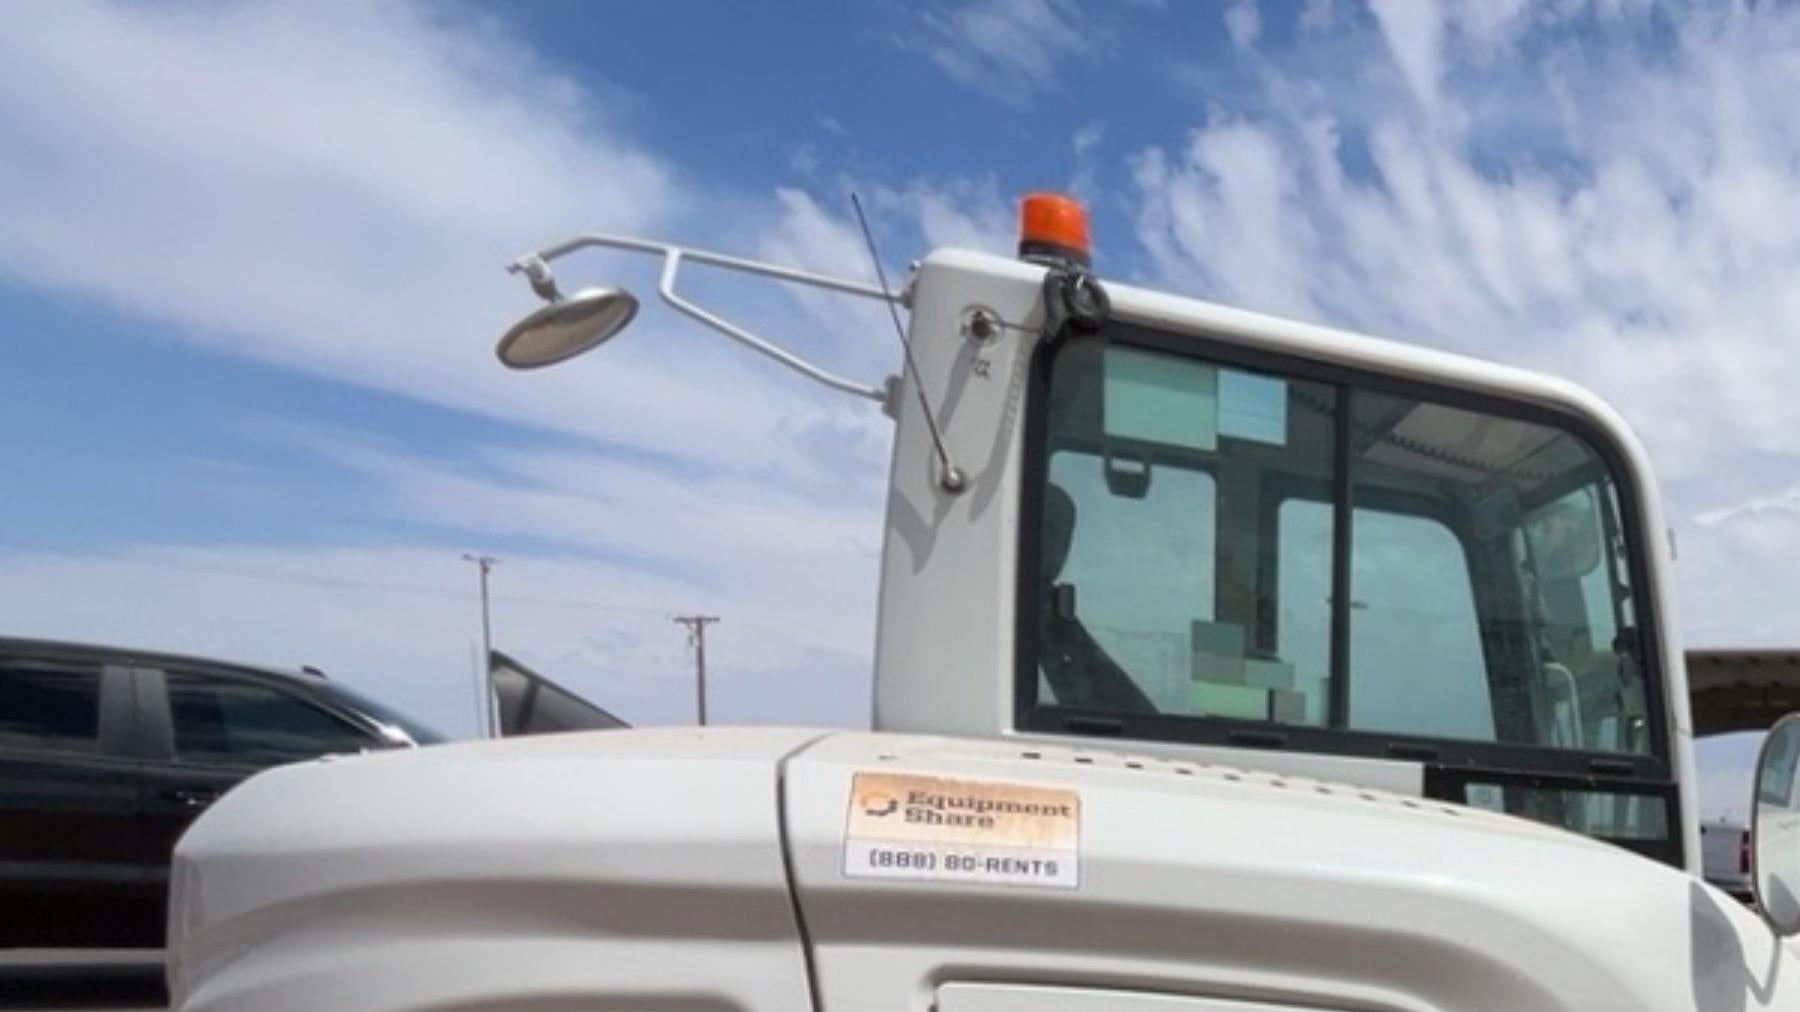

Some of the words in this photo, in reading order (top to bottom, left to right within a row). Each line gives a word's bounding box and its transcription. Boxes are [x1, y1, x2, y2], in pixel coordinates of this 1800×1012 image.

[906, 791, 1071, 818] Equipment
[904, 808, 995, 828] Share
[869, 851, 936, 870] (888)
